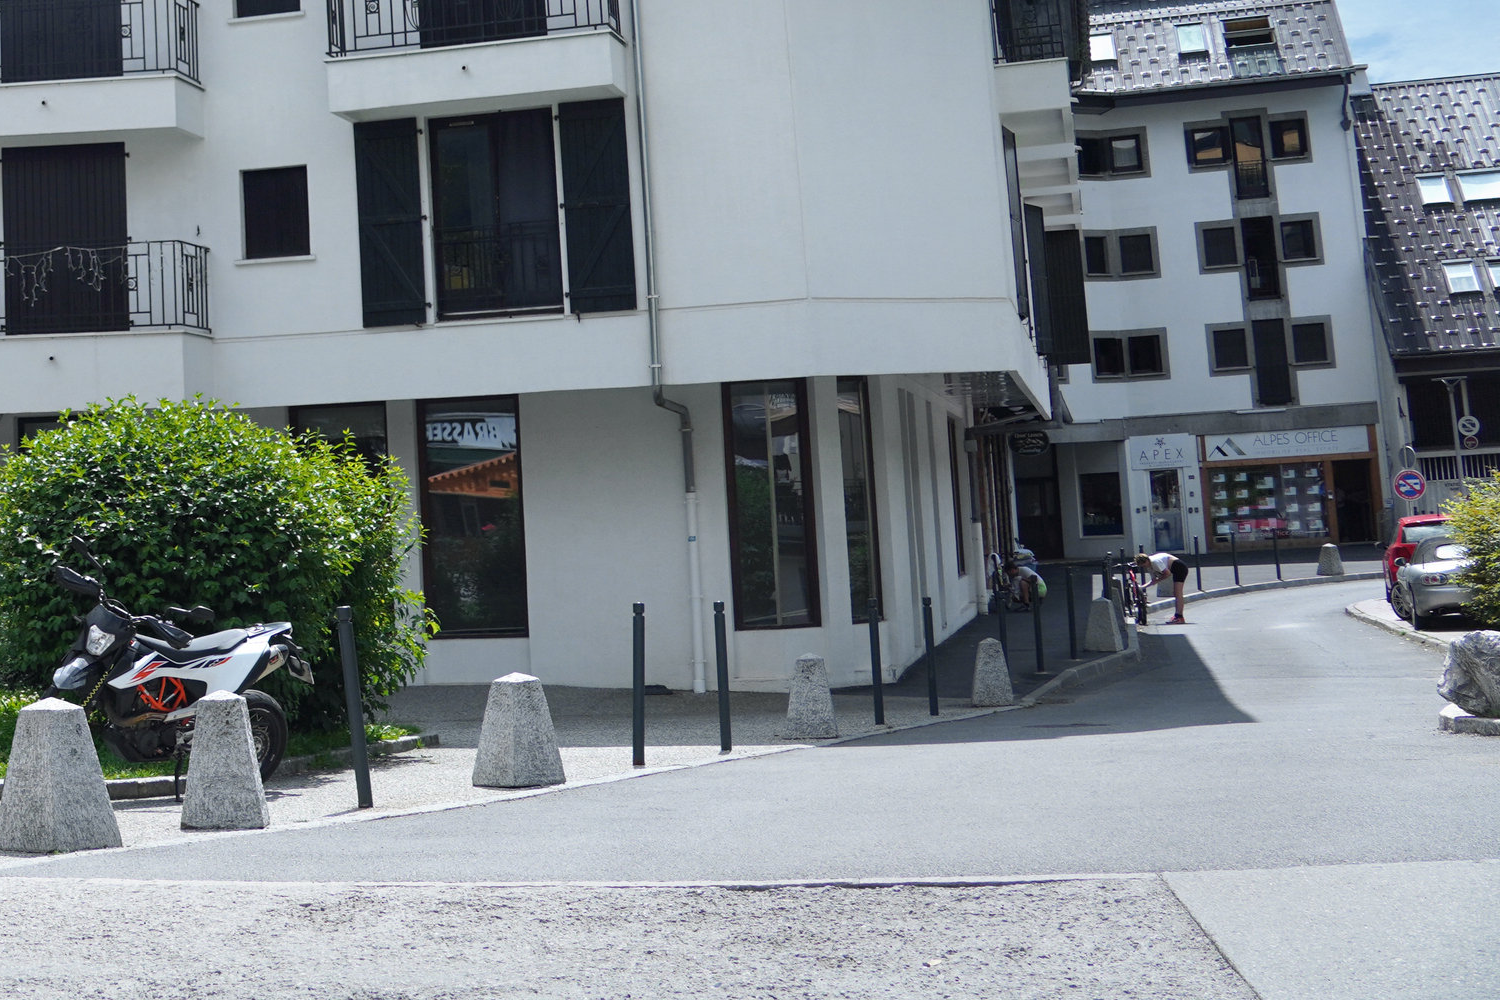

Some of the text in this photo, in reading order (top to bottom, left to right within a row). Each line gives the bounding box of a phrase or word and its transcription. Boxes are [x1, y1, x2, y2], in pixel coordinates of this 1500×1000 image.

[1253, 429, 1338, 446] ALPES OFFICE
[1139, 448, 1184, 461] APEX
